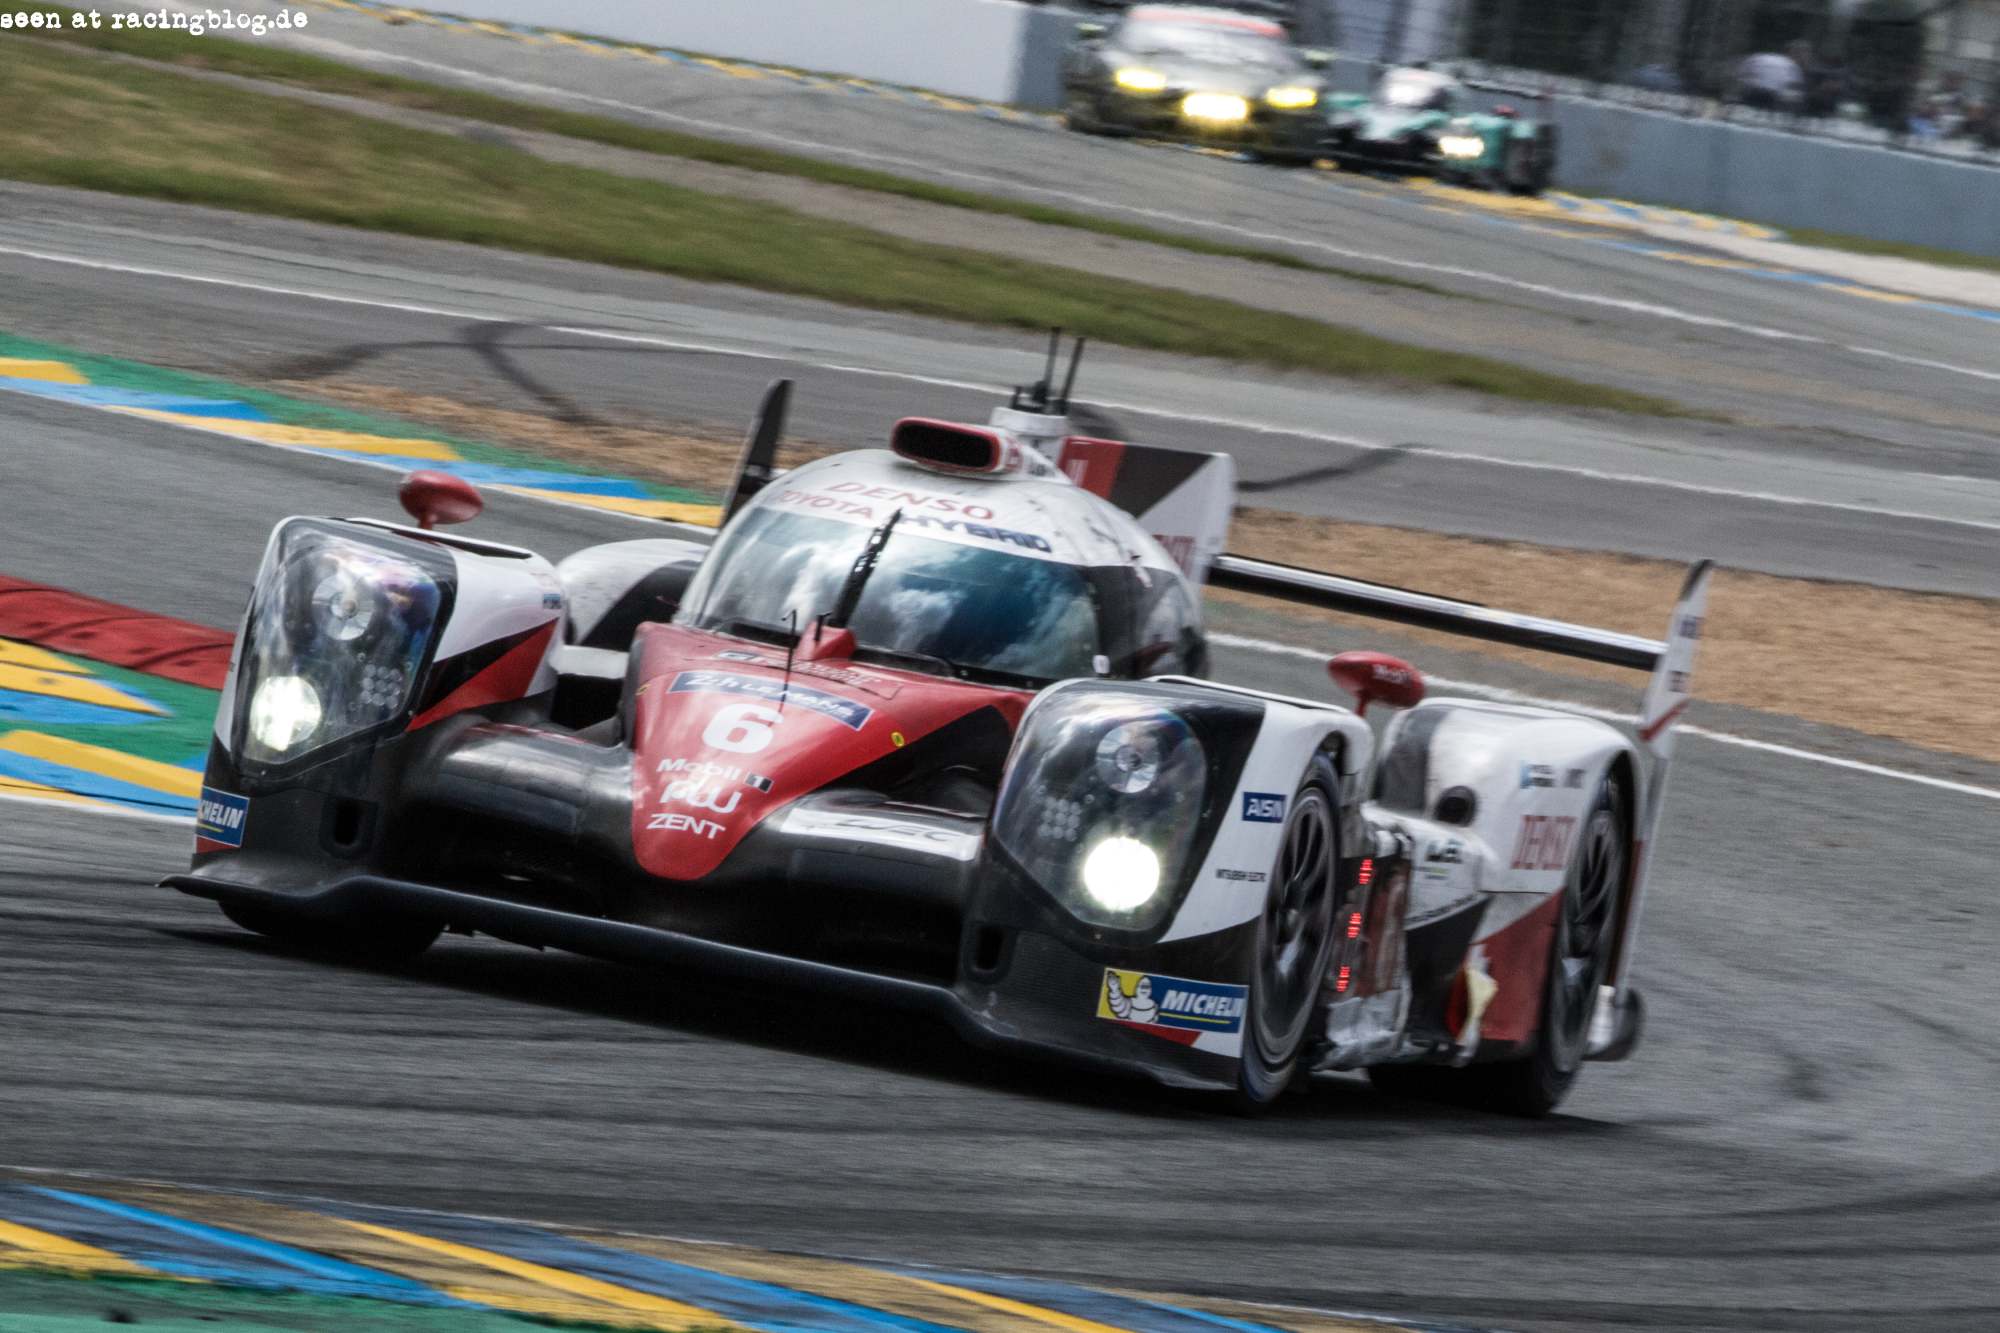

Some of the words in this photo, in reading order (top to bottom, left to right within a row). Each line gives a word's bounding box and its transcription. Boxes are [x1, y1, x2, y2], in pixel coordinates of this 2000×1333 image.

[826, 482, 995, 520] DENSO
[783, 489, 874, 520] TOYOTA
[899, 513, 1053, 554] HYBRID
[702, 703, 784, 754] 6
[656, 758, 742, 781] Mobil
[645, 813, 727, 840] ZENT
